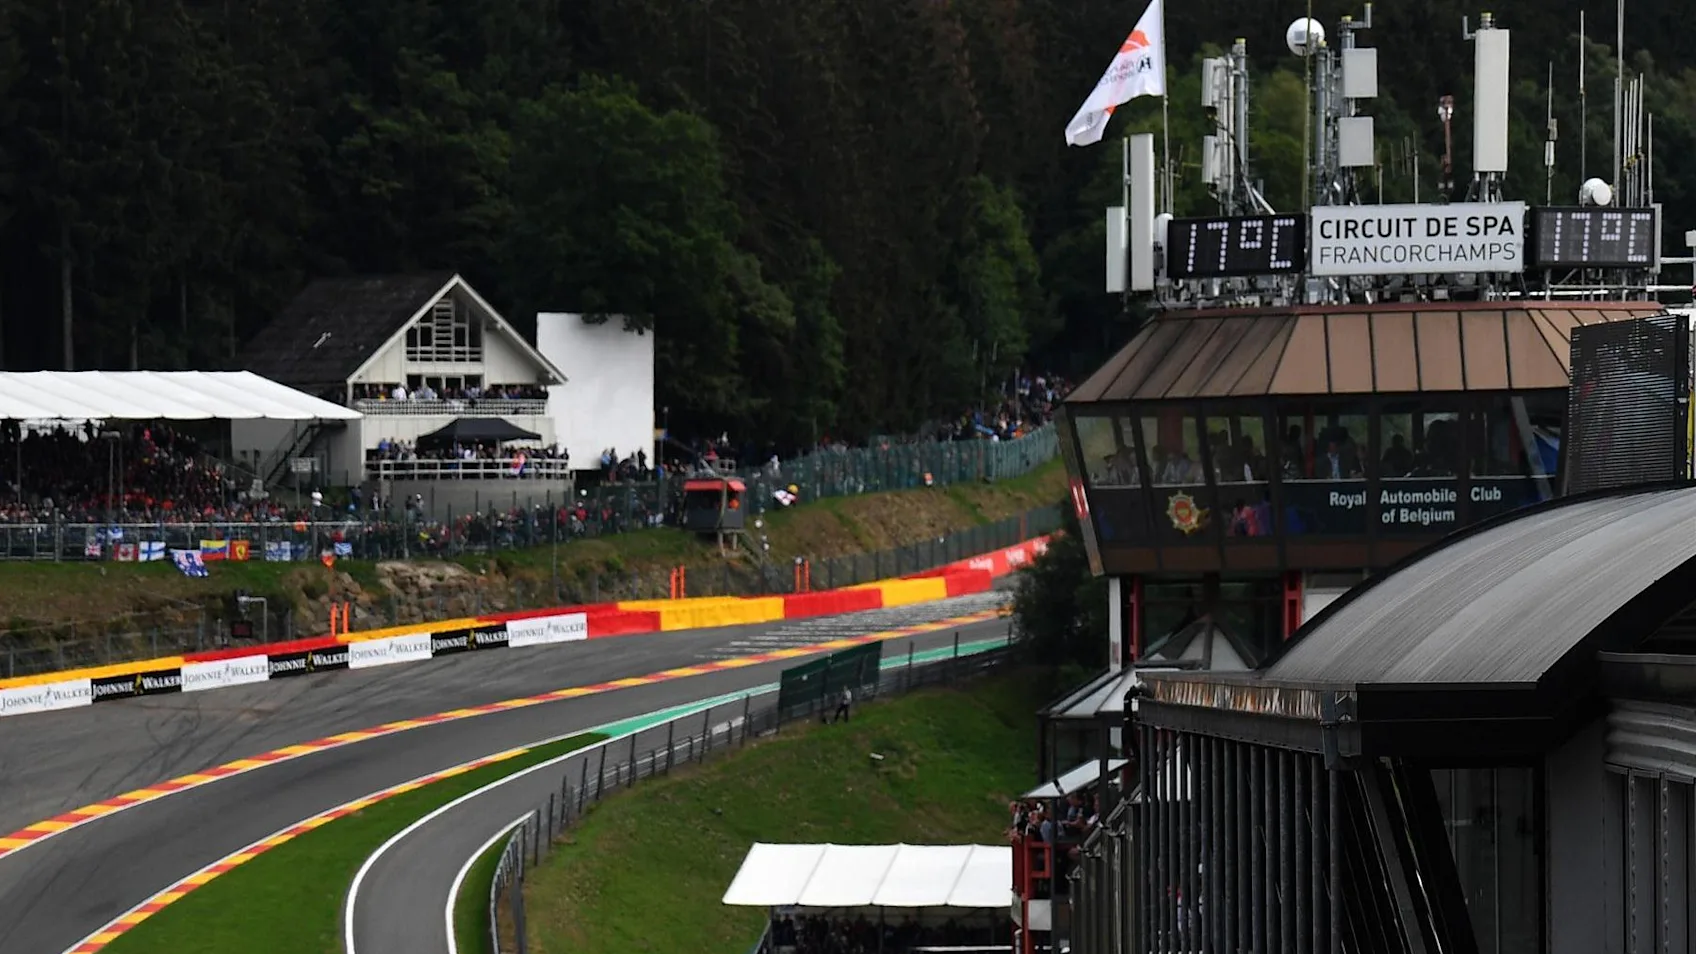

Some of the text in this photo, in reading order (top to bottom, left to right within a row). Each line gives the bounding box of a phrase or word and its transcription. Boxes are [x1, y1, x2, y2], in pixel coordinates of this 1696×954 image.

[1319, 215, 1515, 239] CIRCUIT DE SPA
[1320, 242, 1516, 264] FRANCORCHAMPS
[1329, 486, 1502, 509] Royal Automobile Club
[1381, 507, 1455, 525] of Belgium
[92, 675, 182, 698] JOHNNIE WALKER
